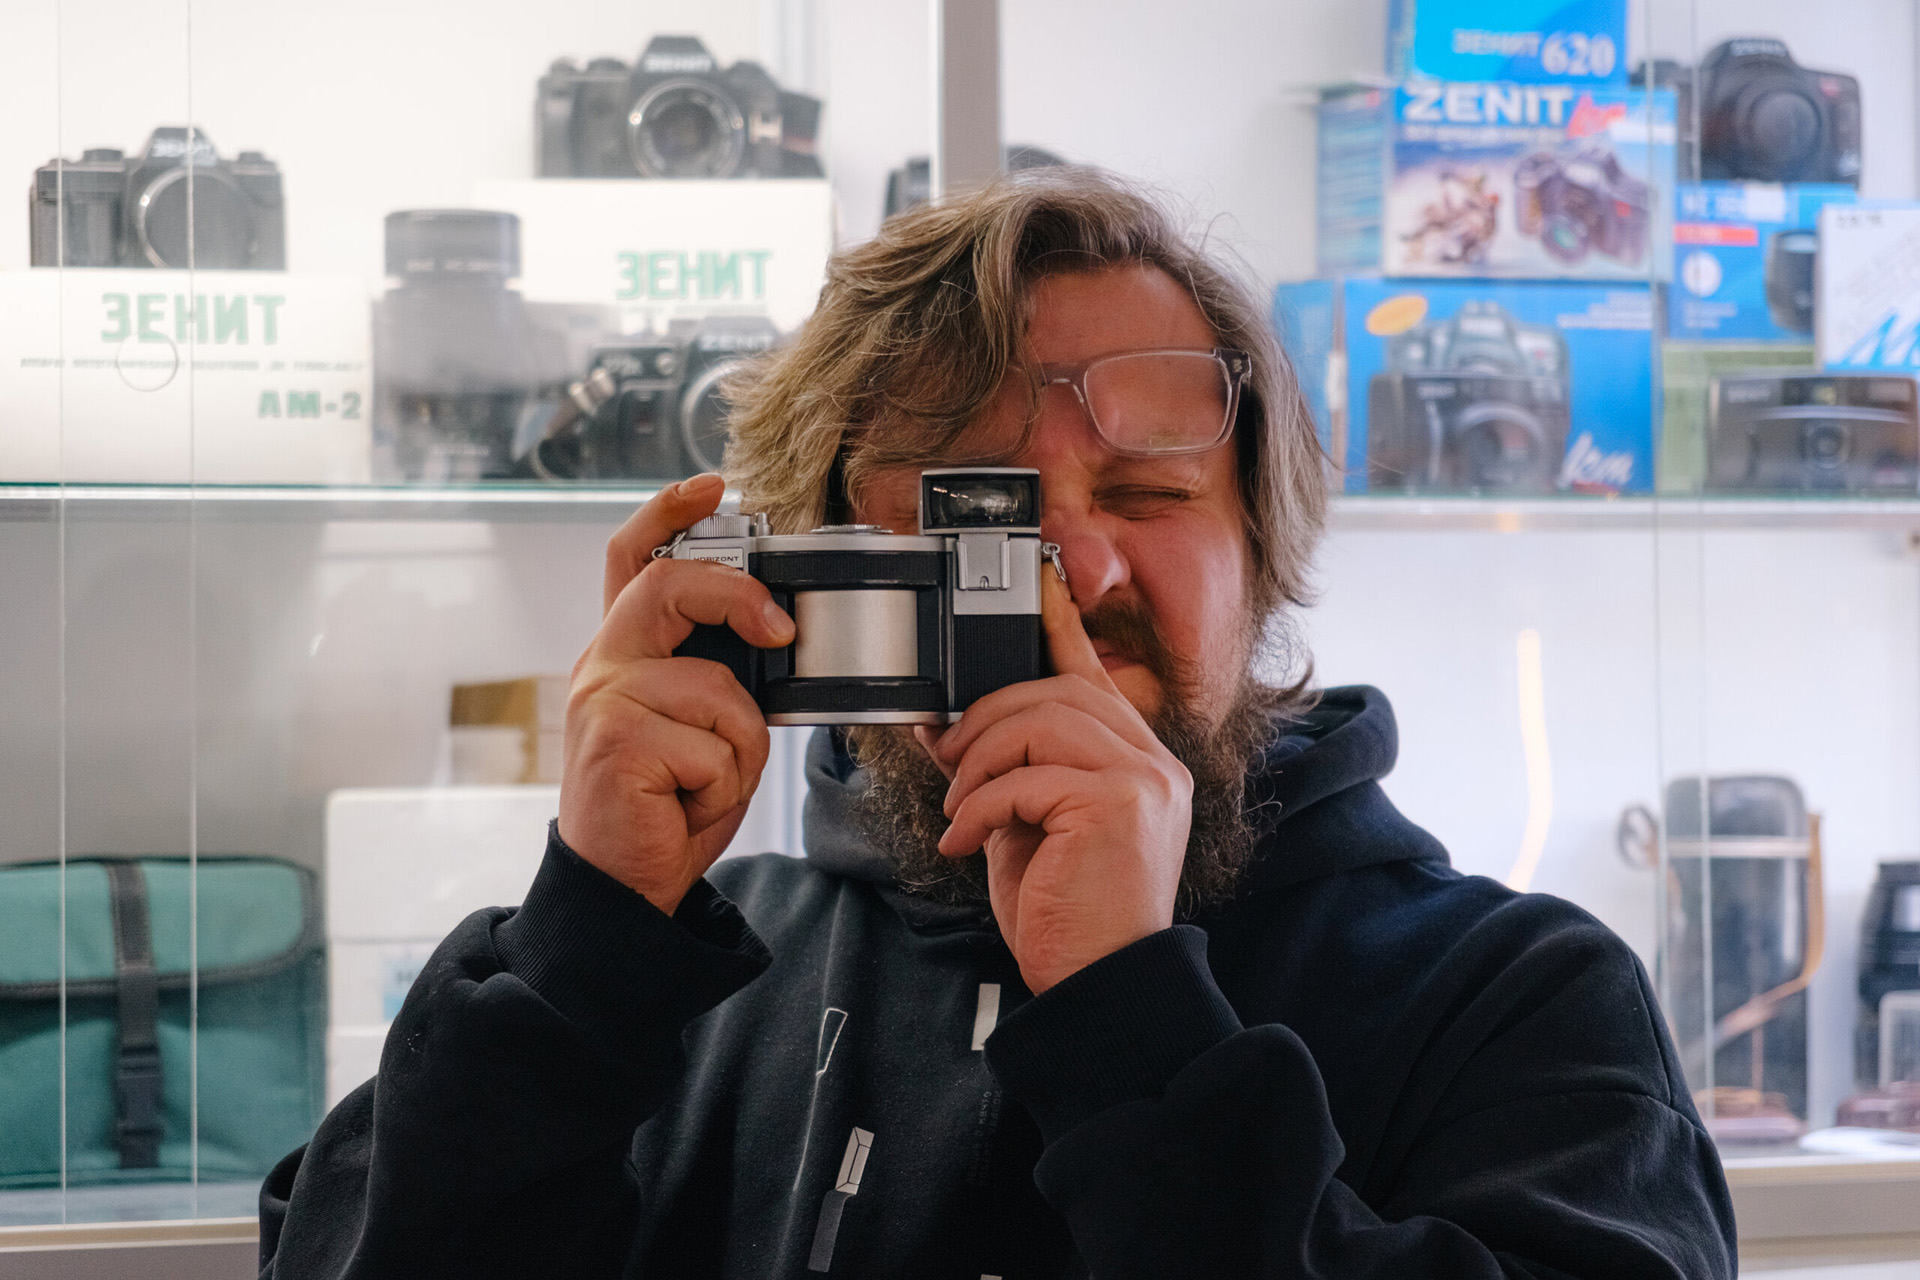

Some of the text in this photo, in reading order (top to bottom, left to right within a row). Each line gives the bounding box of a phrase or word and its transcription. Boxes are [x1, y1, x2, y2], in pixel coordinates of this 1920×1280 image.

[1541, 31, 1616, 78] 620
[1404, 82, 1574, 125] ZENIT
[617, 249, 772, 300] ЗЕНИТ
[101, 292, 286, 345] ЗЕНИТ
